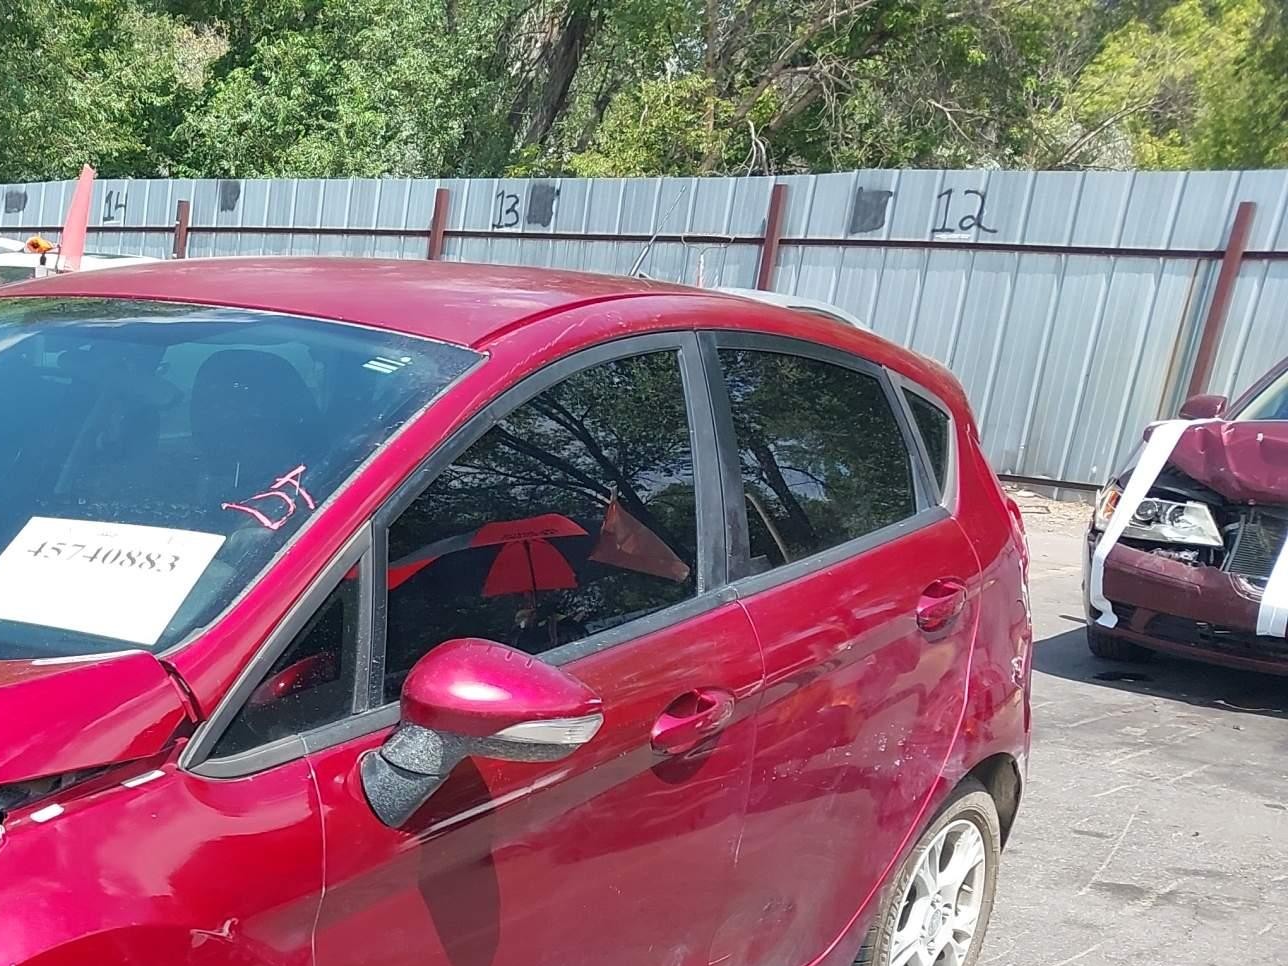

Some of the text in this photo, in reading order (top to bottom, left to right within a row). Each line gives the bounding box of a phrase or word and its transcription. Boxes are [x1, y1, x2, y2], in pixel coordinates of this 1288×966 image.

[103, 190, 128, 225] 14
[492, 190, 520, 229] 13
[931, 188, 998, 233] 12
[27, 541, 181, 573] 45740883
